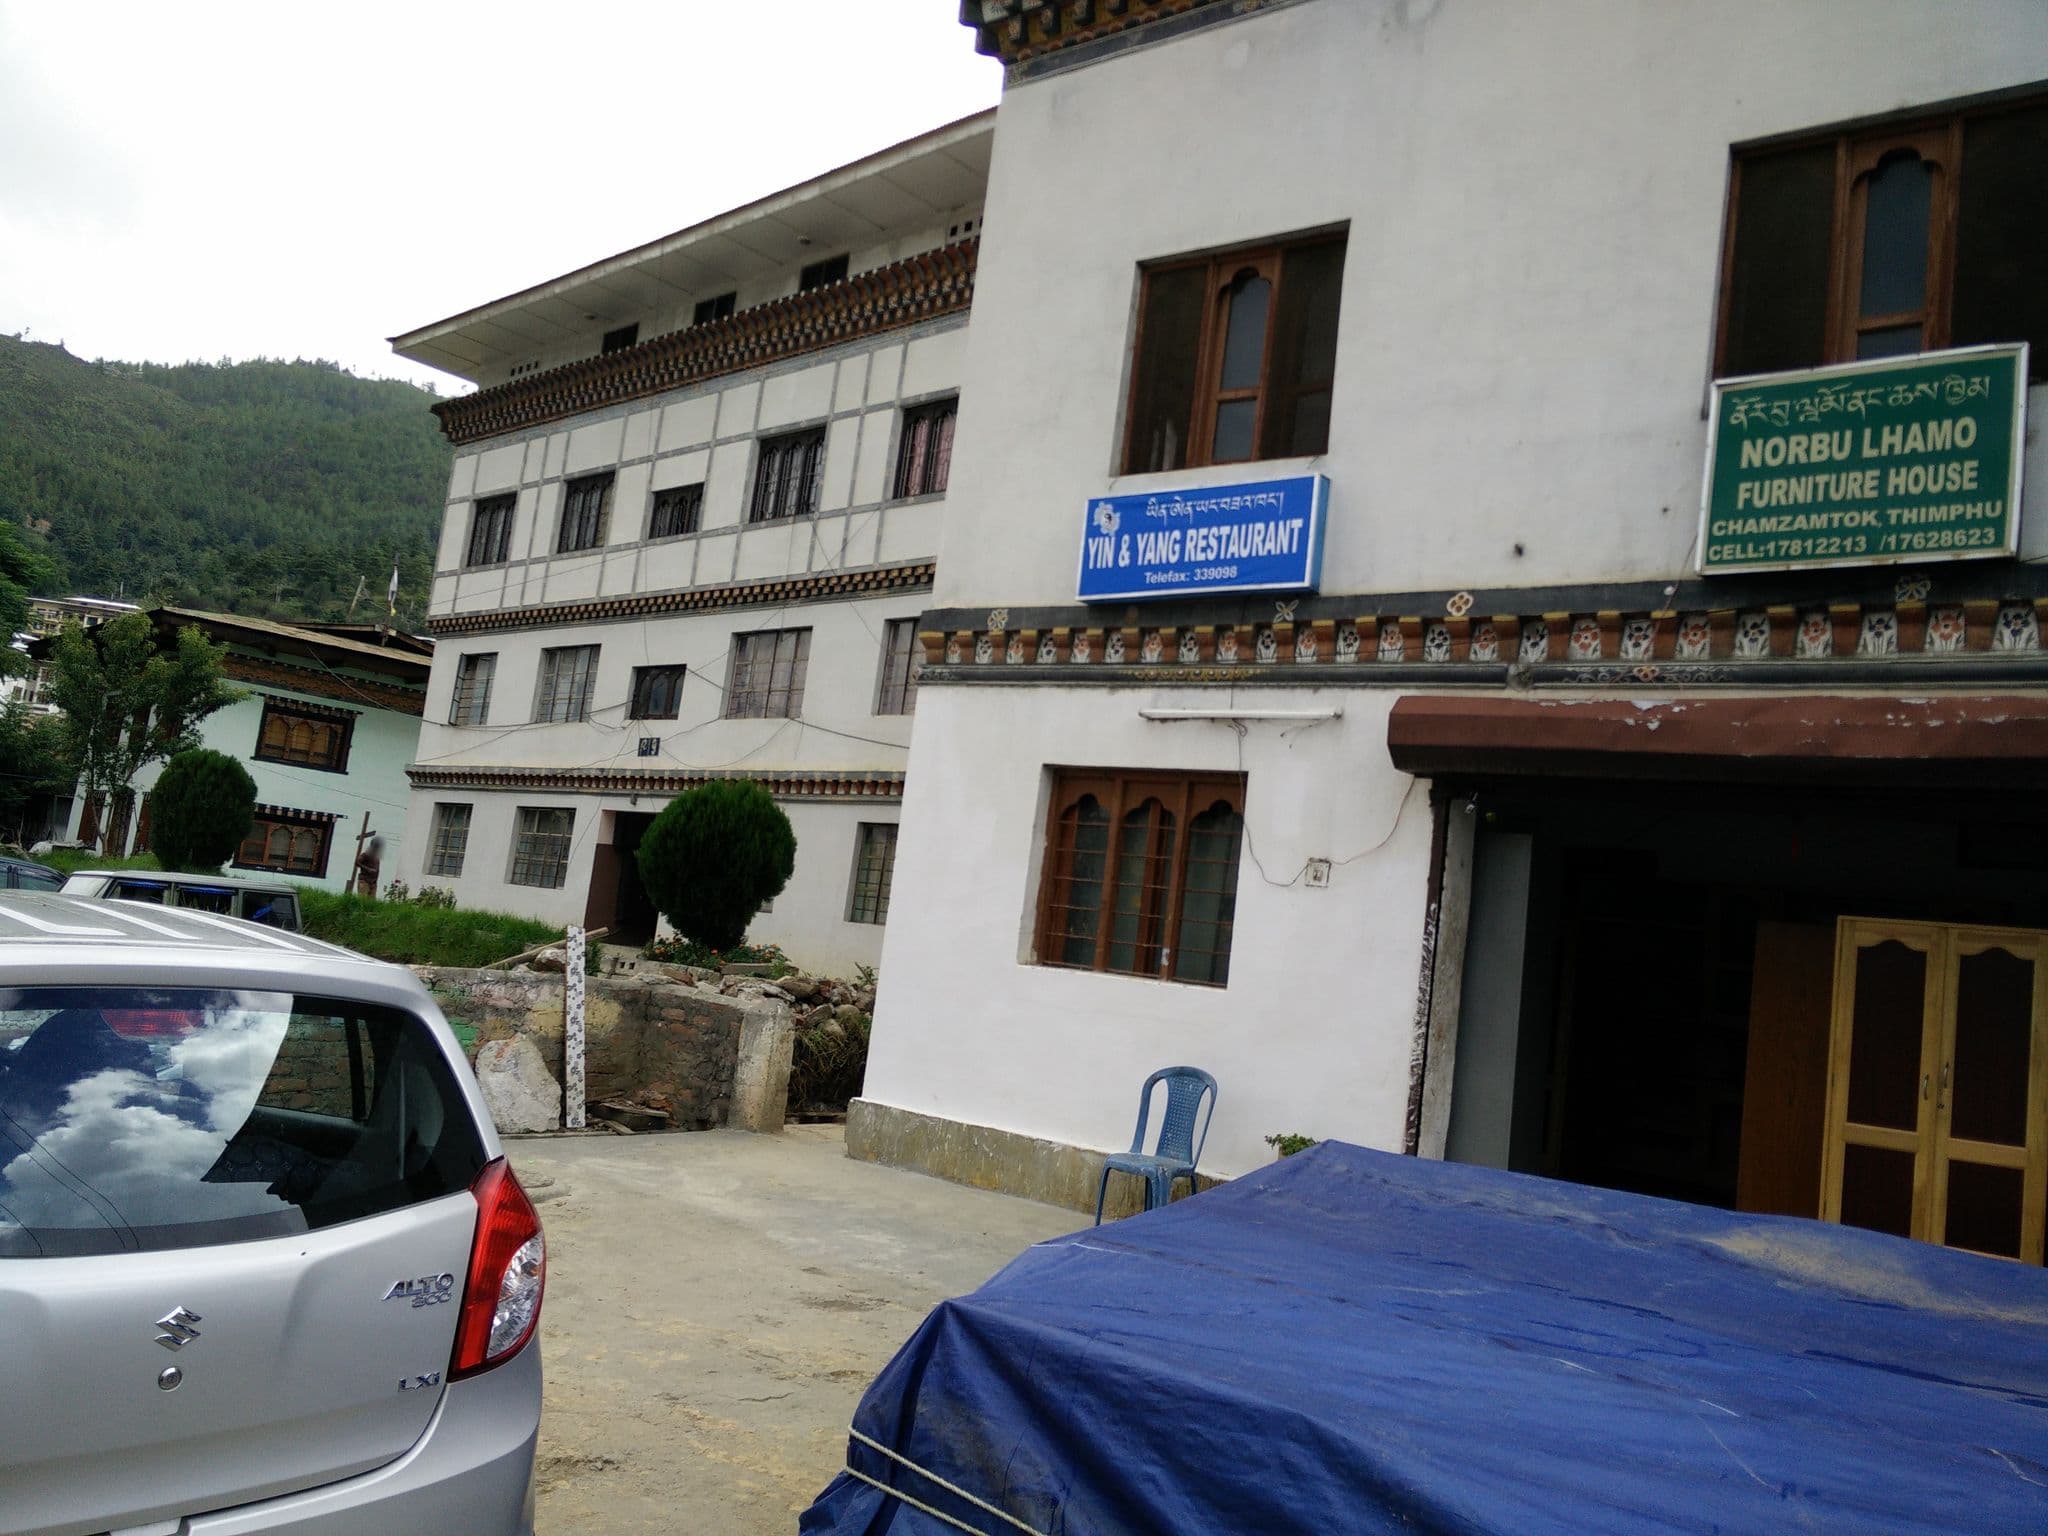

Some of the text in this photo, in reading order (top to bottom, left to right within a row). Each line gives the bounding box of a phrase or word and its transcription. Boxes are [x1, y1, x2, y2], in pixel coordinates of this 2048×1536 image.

[1740, 416, 1977, 469] NORBU LHAMO
[1736, 460, 1979, 510] FURNITURE HOUSE
[1887, 500, 2002, 526] THIMPHU
[1088, 519, 1303, 569] YIN & YANG RESTAURANT
[1145, 566, 1237, 584] Telefax: 339098
[381, 1272, 454, 1301] ALTO
